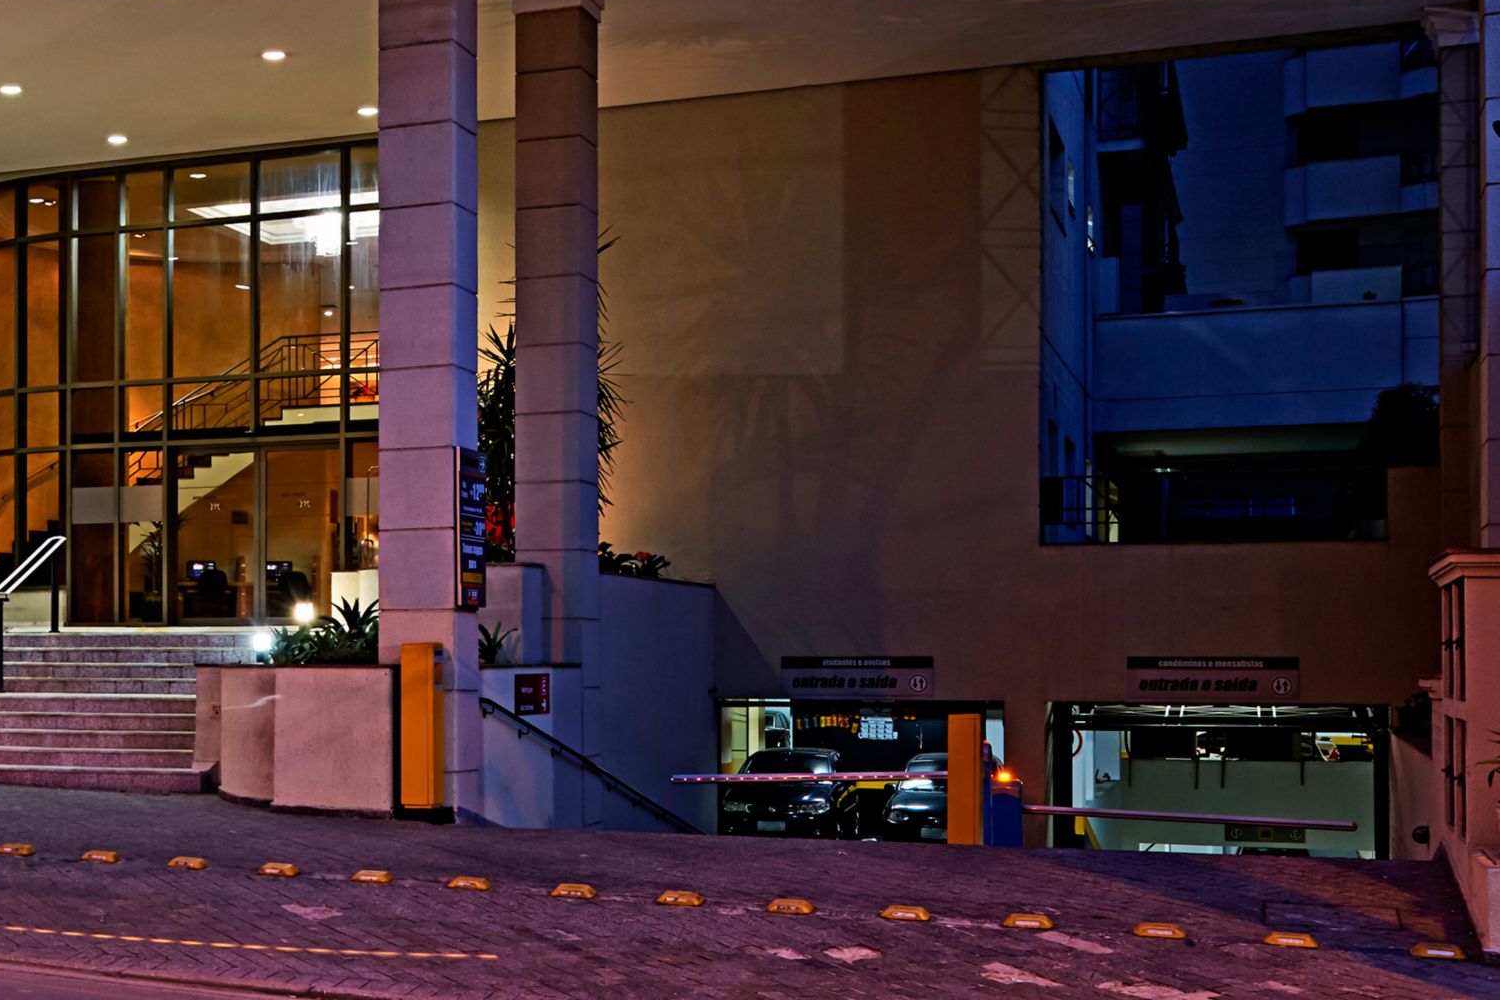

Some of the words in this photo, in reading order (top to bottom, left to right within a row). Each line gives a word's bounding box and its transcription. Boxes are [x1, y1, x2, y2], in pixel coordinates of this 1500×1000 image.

[792, 675, 845, 689] entrada
[847, 677, 856, 689] e
[858, 675, 898, 689] saída
[1139, 677, 1198, 692] entrada
[1201, 679, 1211, 692] e
[1214, 677, 1258, 692] saída
